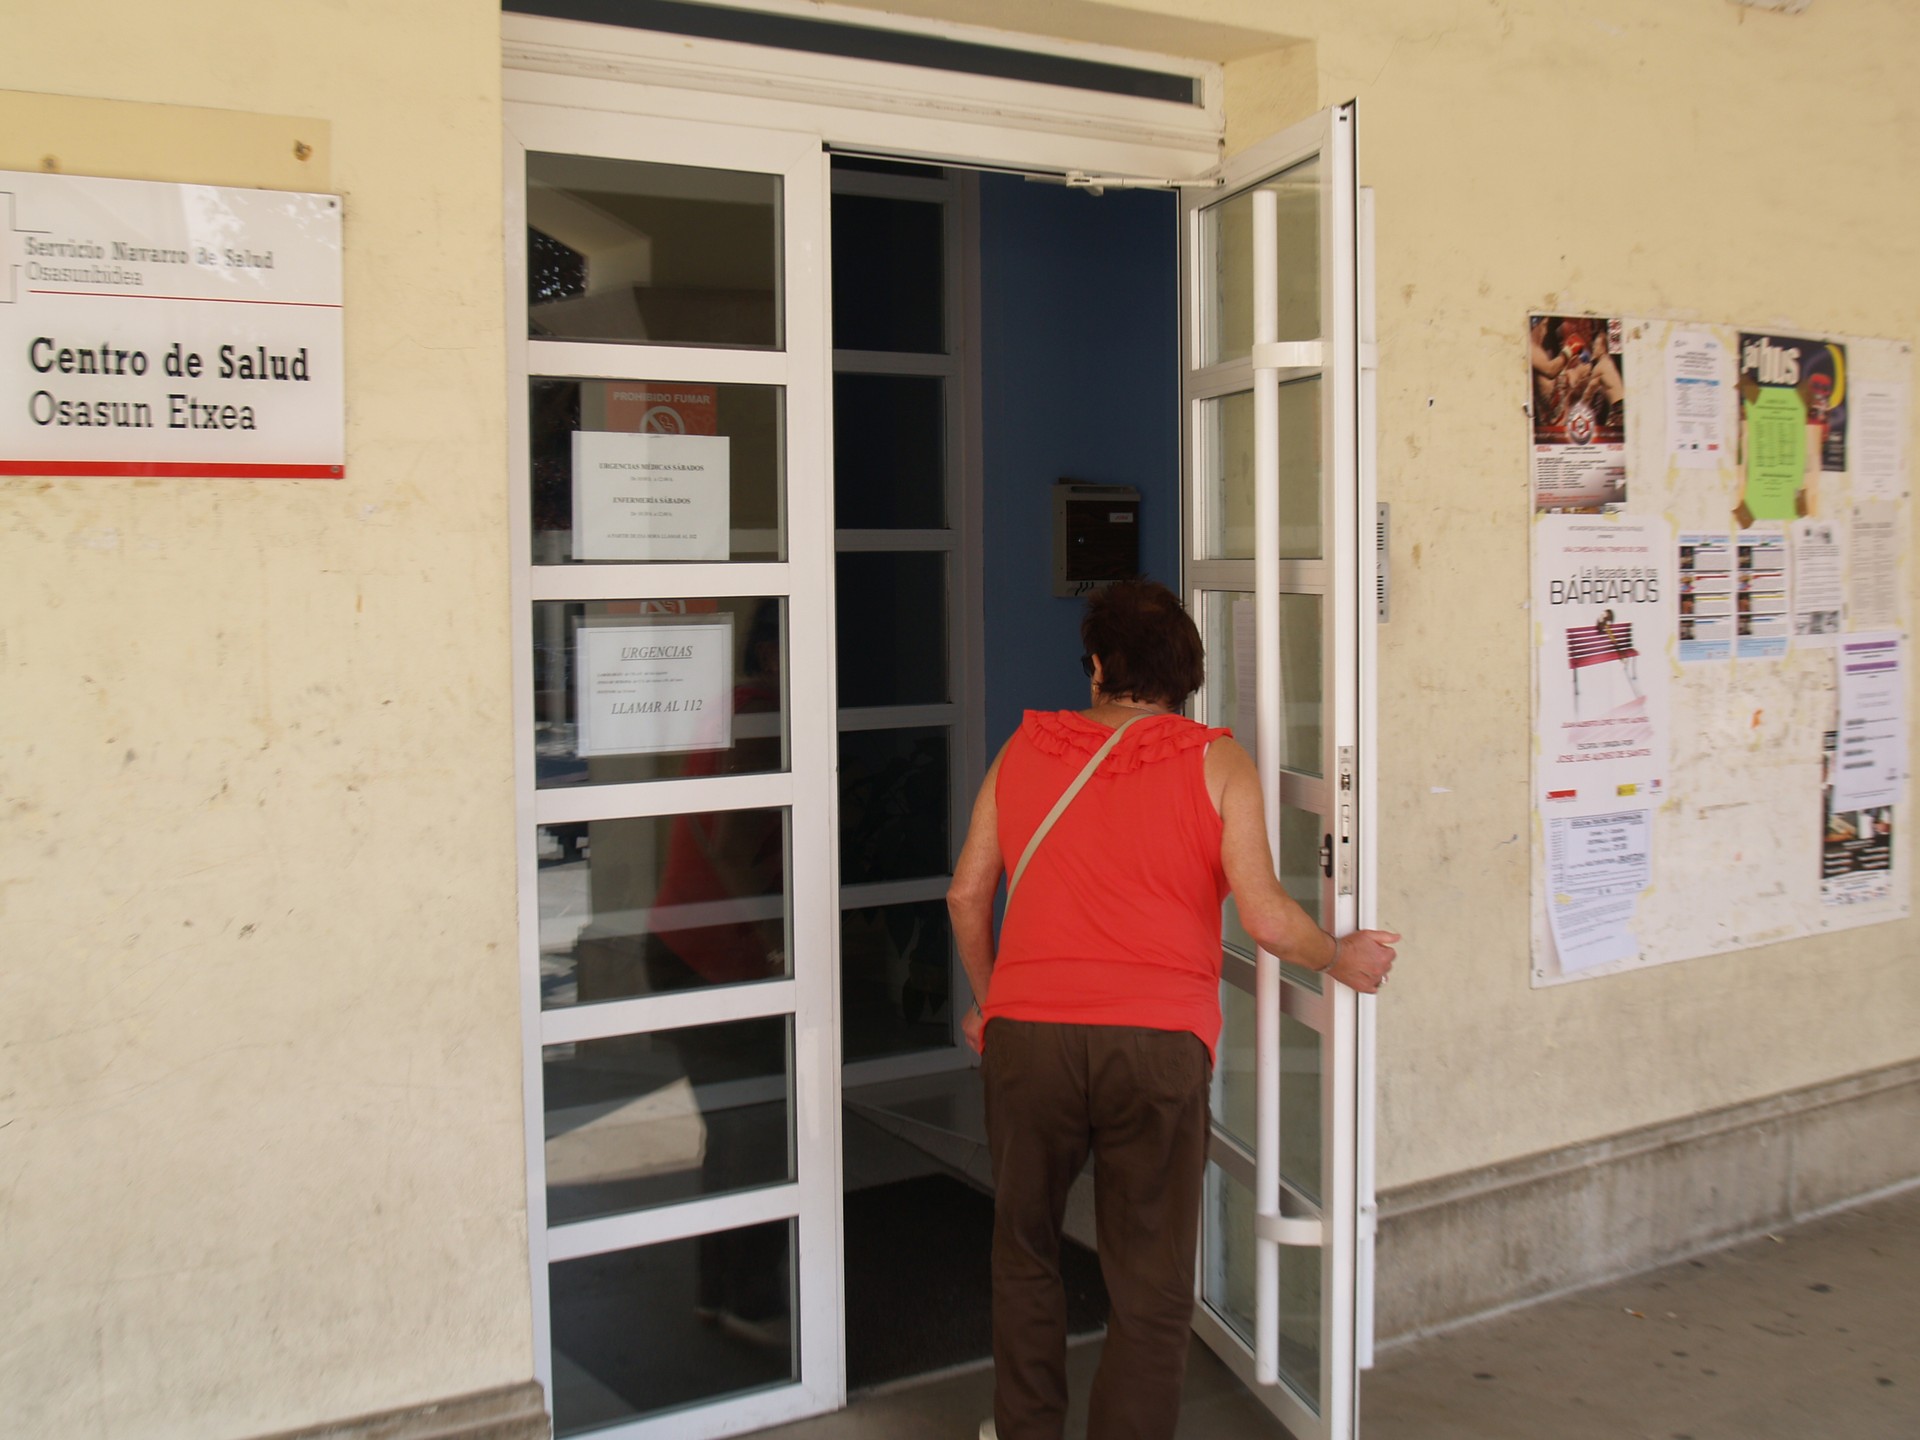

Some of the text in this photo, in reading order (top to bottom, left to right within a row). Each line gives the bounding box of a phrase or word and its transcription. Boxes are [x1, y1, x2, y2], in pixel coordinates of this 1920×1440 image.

[25, 236, 275, 269] Servicio Navarro de Salud
[25, 260, 144, 286] Osasunbidea
[29, 336, 311, 381] Centro de Salud
[613, 391, 710, 405] PROHIBIDO FUMAR
[29, 389, 257, 430] Osasun Etxea
[598, 462, 640, 470] URGENCIAS
[1580, 566, 1592, 579] La
[1550, 574, 1660, 605] BÁRBAROS
[621, 645, 694, 659] URGENCIAS
[611, 699, 703, 715] LLAMAR AL 112
